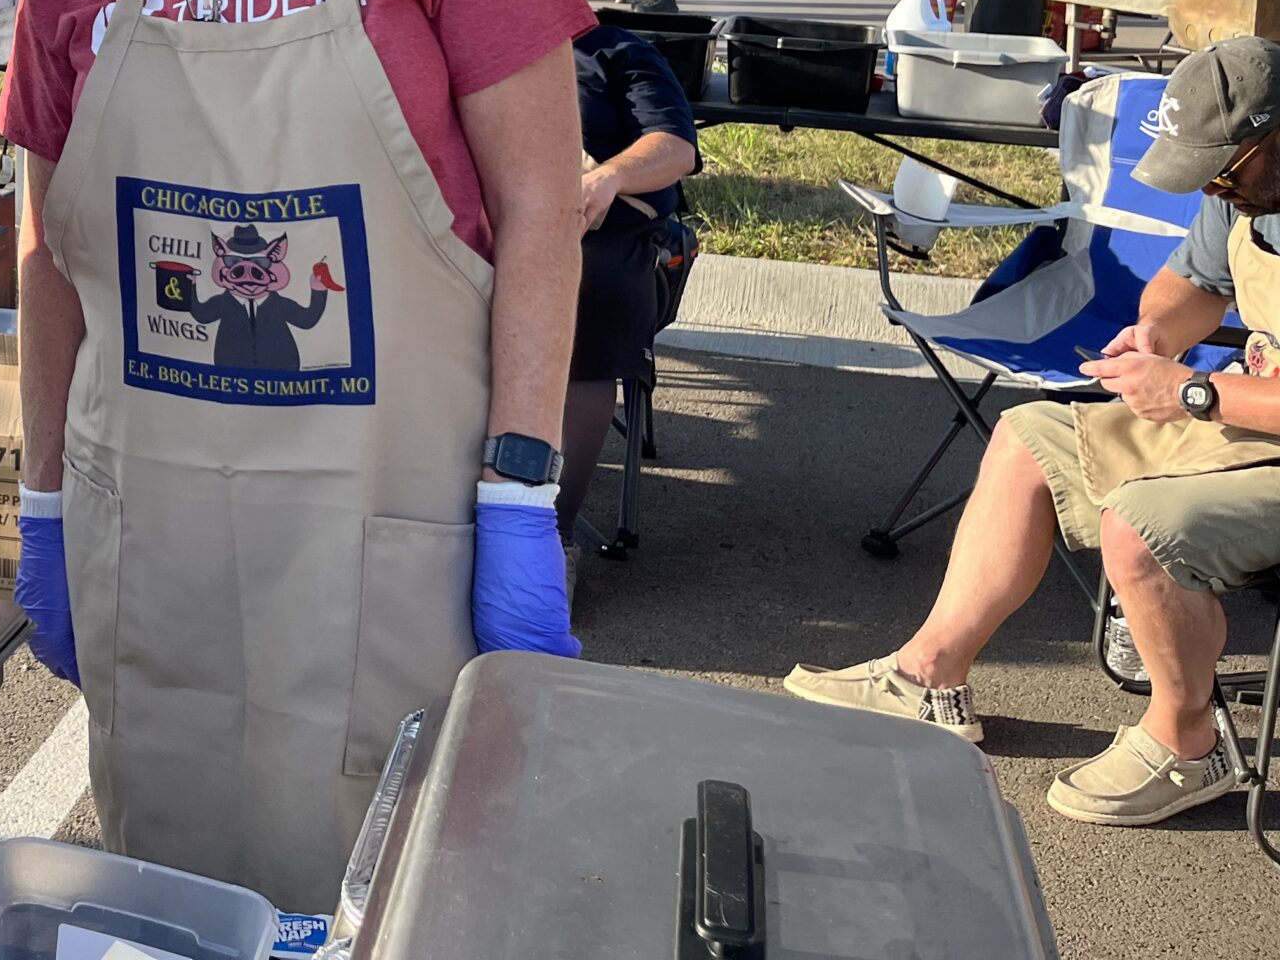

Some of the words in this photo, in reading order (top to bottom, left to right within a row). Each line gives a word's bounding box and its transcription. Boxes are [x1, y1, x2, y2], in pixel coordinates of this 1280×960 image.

[141, 186, 241, 219] CHICAGO
[244, 194, 326, 220] STYLE
[148, 234, 202, 260] CHILI
[164, 277, 184, 302] &
[147, 314, 209, 343] WINGS
[127, 358, 153, 380] E.R.
[158, 366, 249, 394] BBQ-LEE'S
[254, 378, 335, 397] SUMMIT,
[341, 377, 370, 394] MO
